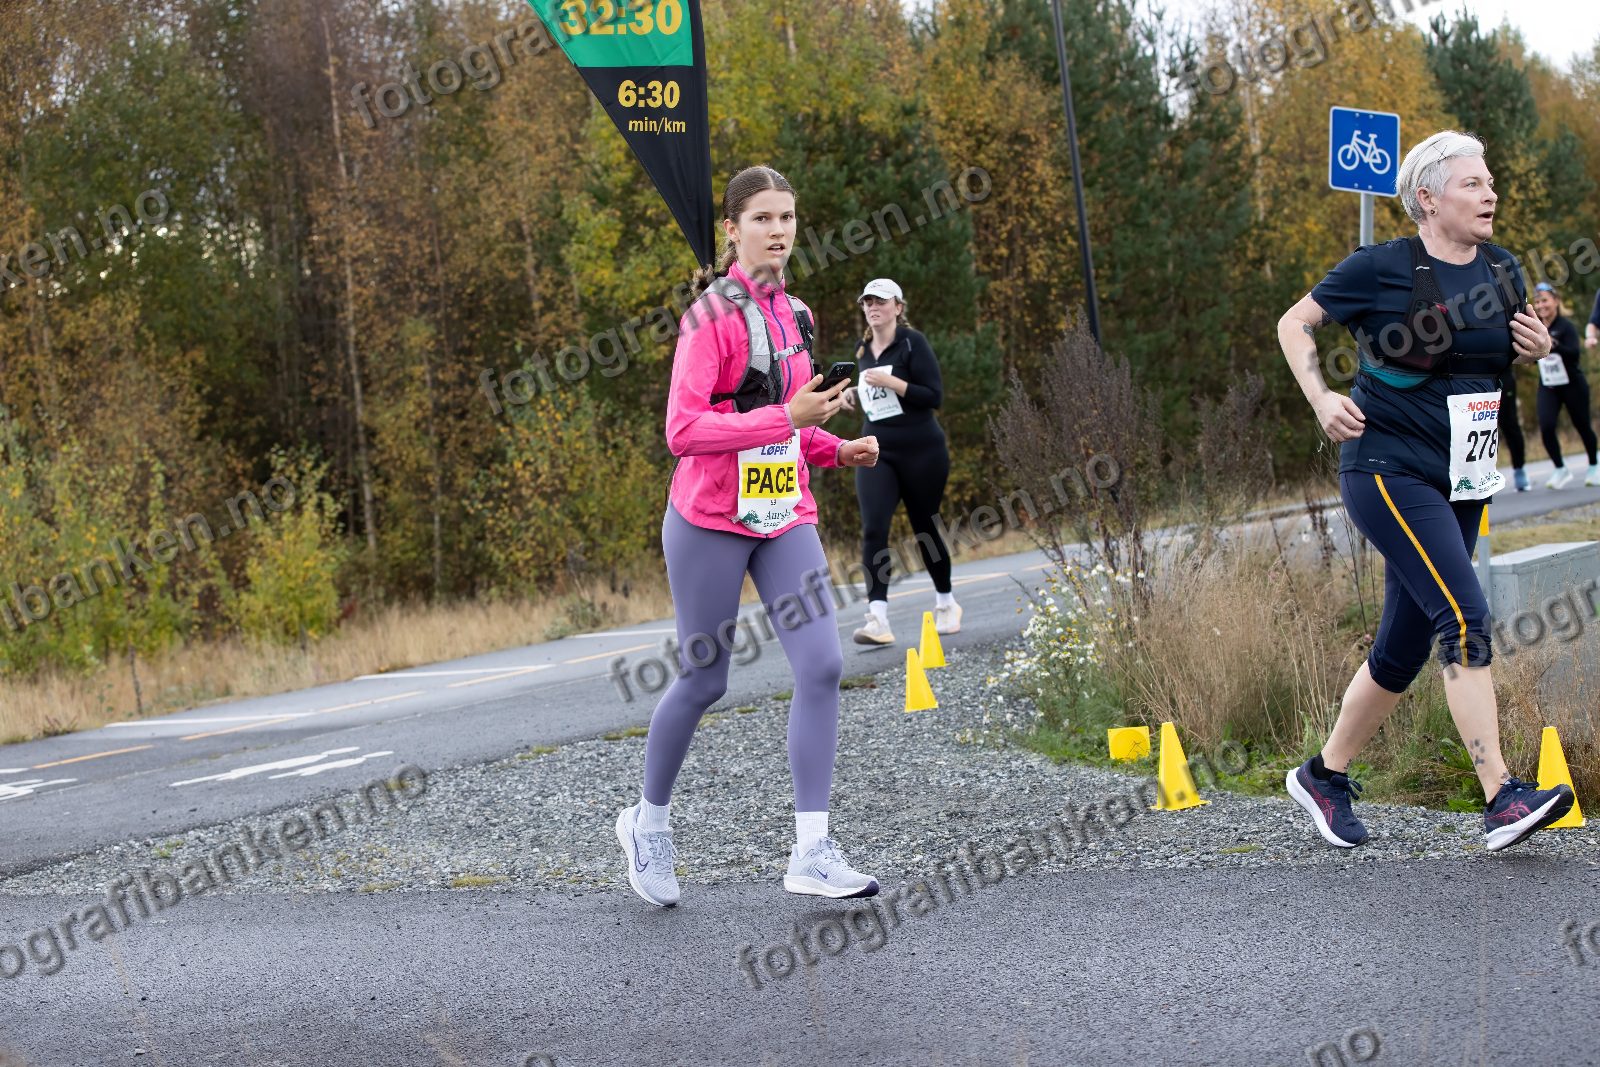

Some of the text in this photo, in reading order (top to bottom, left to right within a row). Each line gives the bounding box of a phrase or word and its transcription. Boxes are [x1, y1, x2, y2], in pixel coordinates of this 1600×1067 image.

[560, 0, 682, 35] 32:30
[618, 80, 680, 109] 6:30
[629, 117, 686, 135] min/km
[865, 386, 888, 402] 123
[1472, 410, 1498, 421] LØPE
[761, 446, 788, 455] LØPET
[747, 467, 795, 493] PACE
